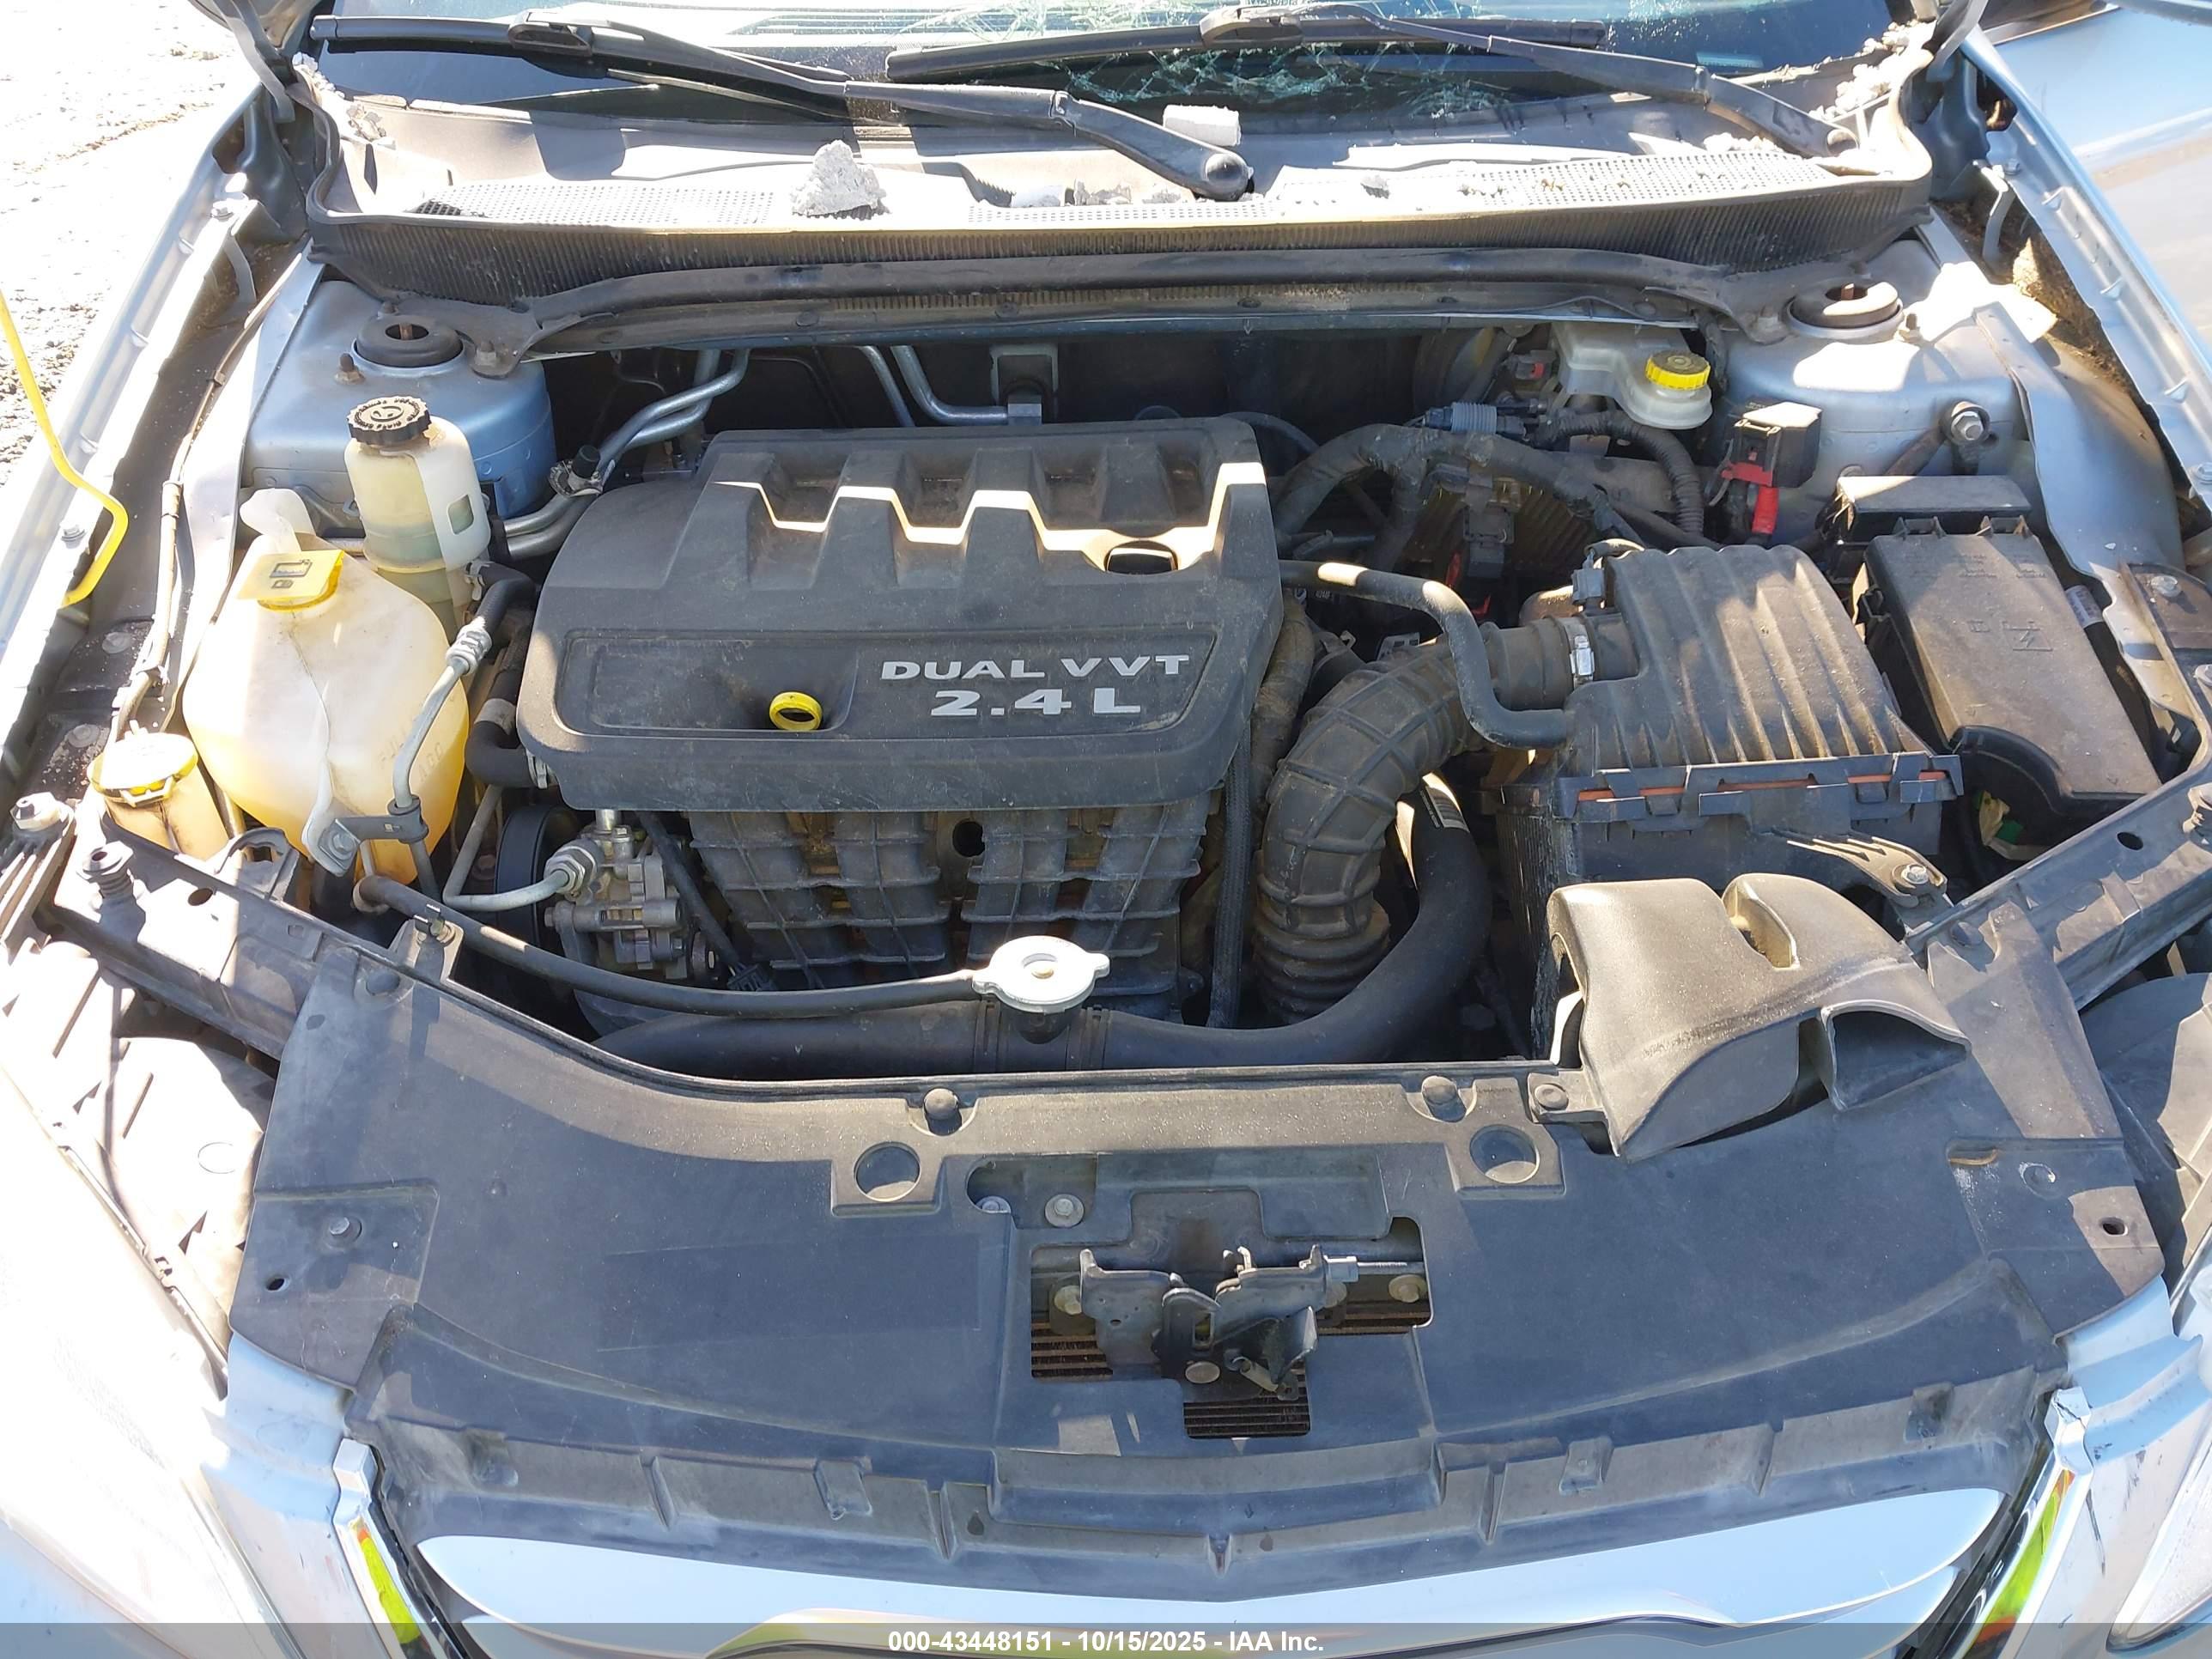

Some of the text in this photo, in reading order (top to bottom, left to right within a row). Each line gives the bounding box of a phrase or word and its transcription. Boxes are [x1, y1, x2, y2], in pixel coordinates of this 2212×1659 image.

[881, 654, 1190, 680] DUAL VVT
[930, 686, 1142, 716] 2.4 L
